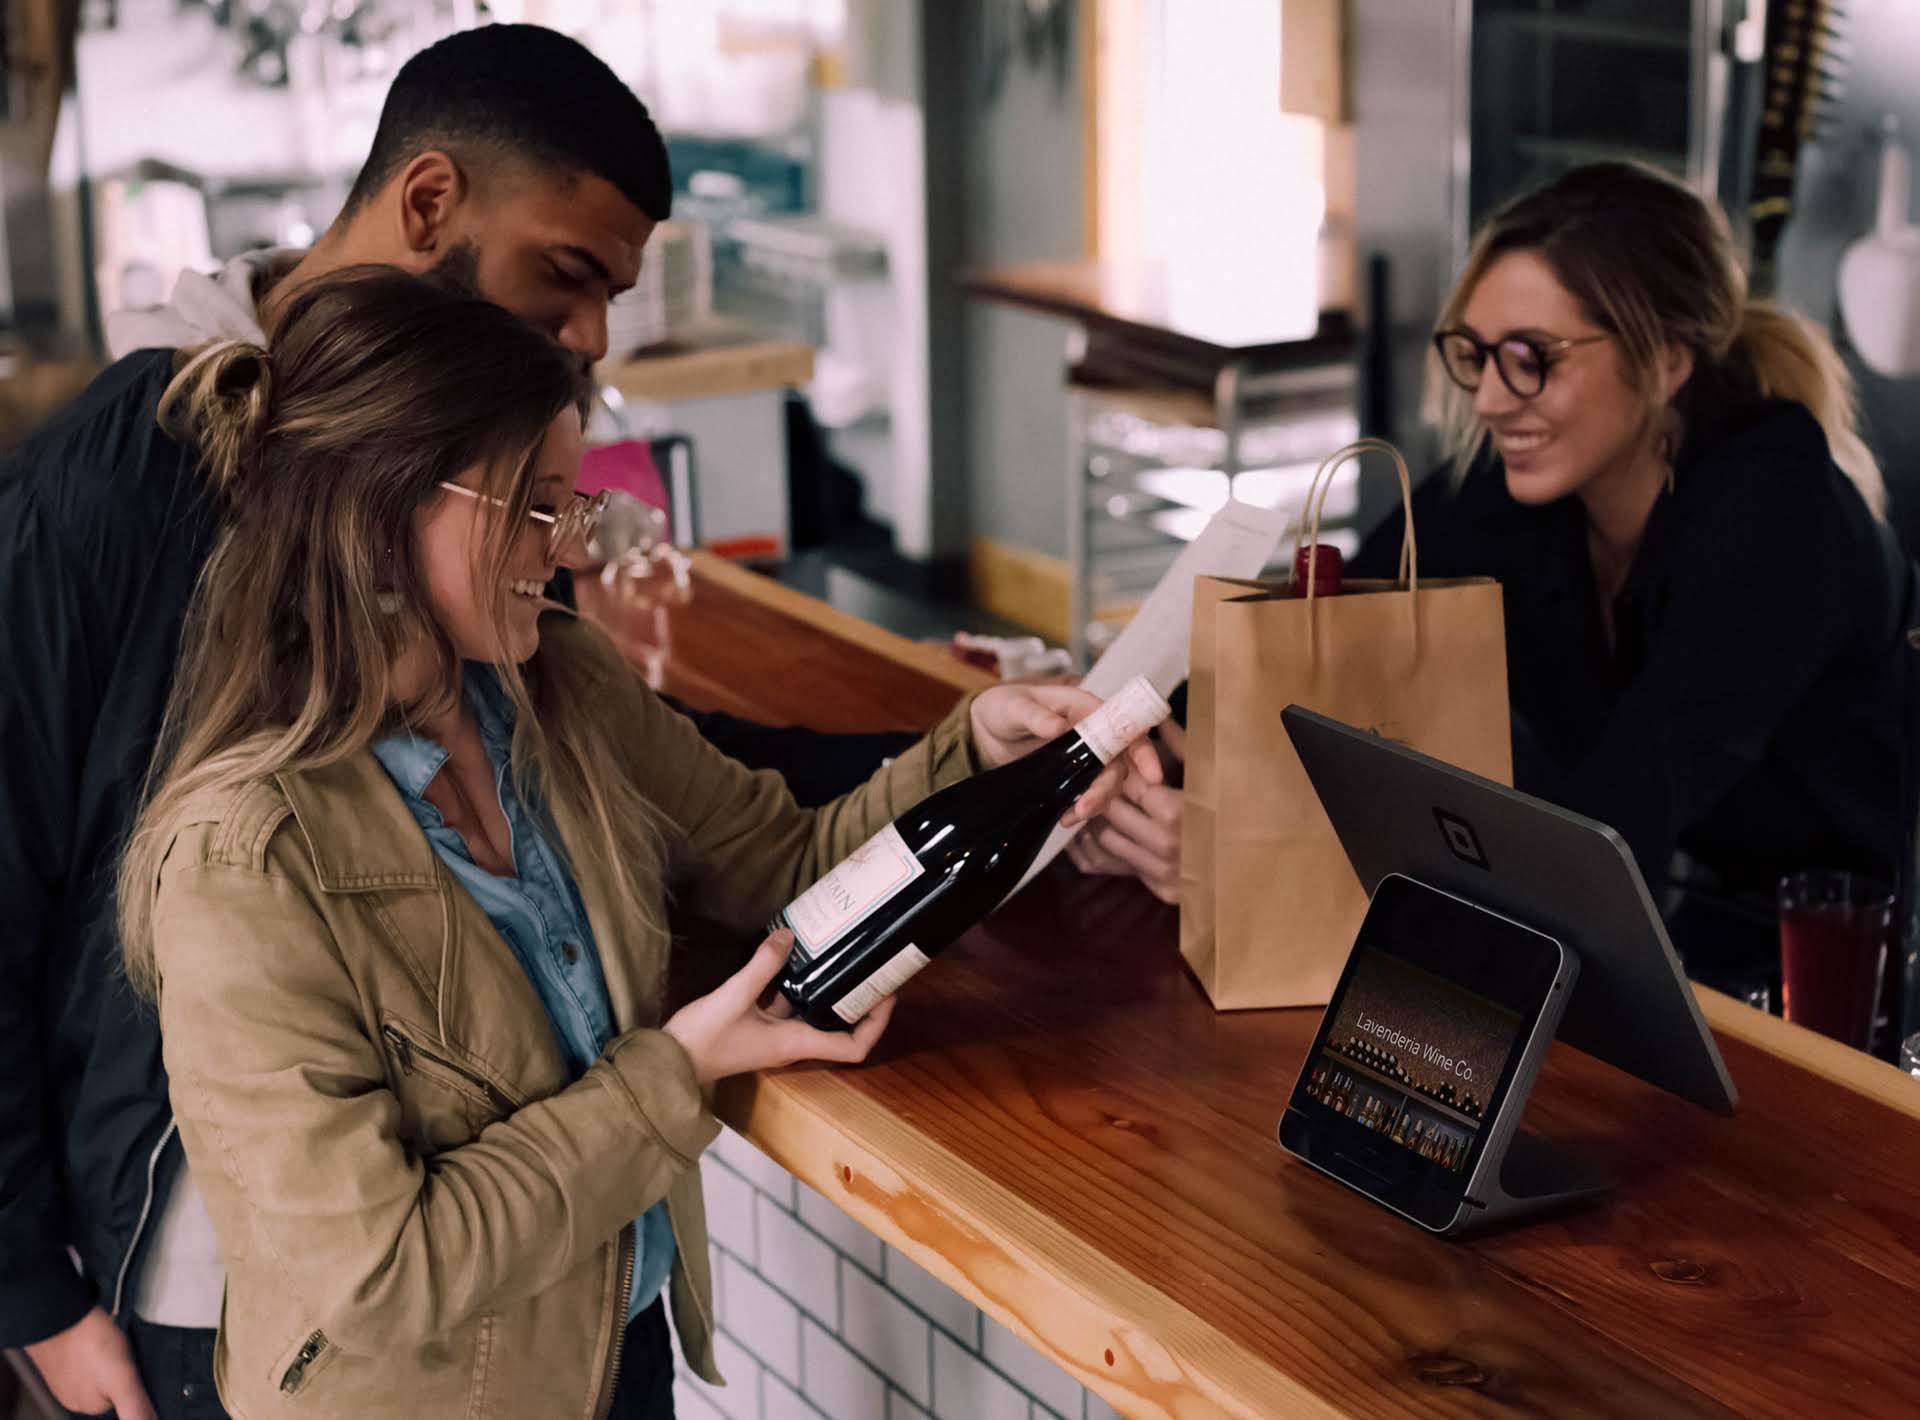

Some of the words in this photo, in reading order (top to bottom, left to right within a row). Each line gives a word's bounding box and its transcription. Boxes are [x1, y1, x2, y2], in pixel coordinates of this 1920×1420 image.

[1356, 1012, 1420, 1055] Lavenderia
[1423, 1043, 1453, 1071] Wine
[1455, 1060, 1473, 1082] Co.
